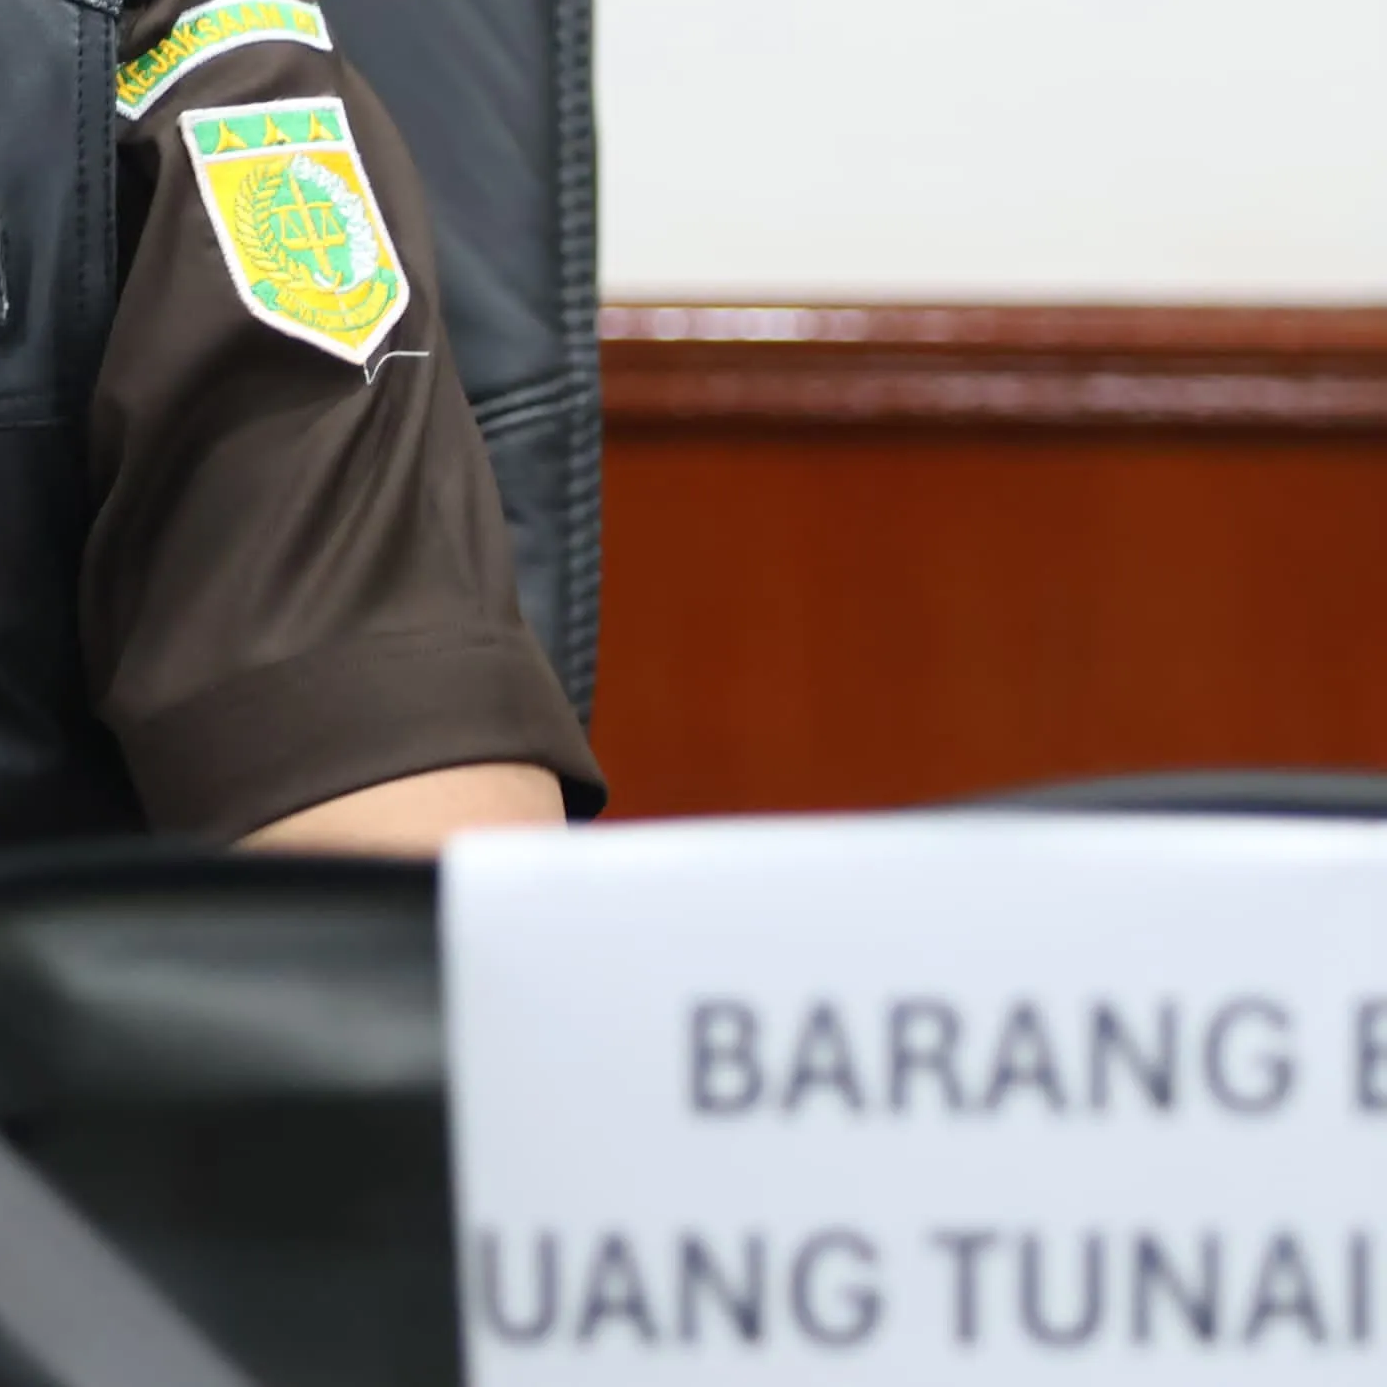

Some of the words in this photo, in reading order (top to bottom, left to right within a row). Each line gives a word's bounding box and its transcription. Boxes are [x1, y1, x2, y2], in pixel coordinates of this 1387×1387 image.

[116, 2, 285, 104] KEJAKSAAN
[687, 996, 1297, 1117] BARANG
[475, 1226, 887, 1350] UANG
[931, 1226, 1370, 1350] TUNAI
